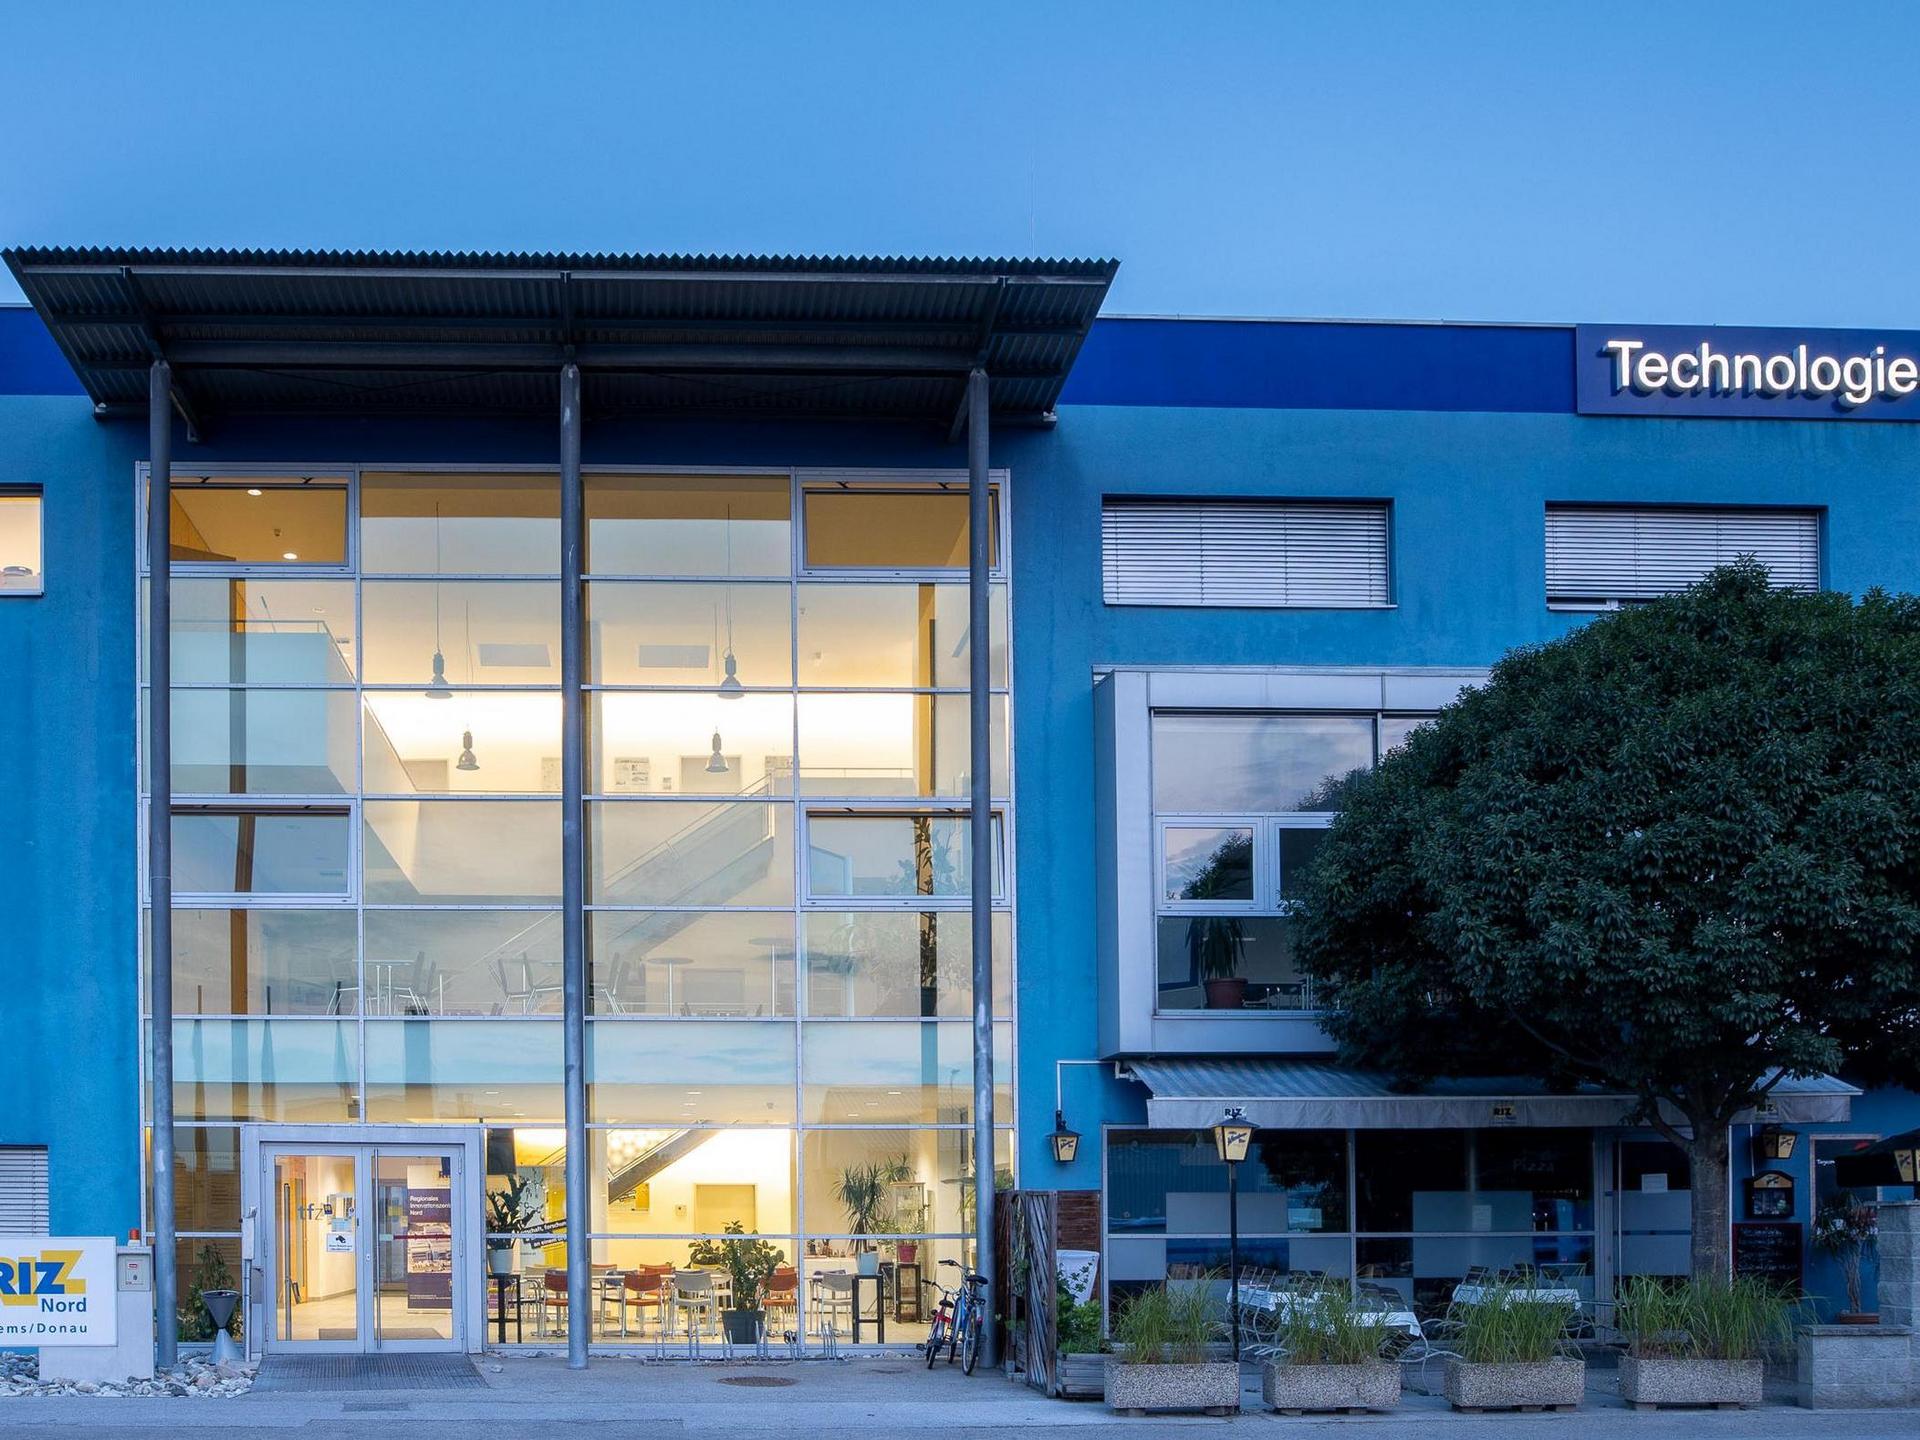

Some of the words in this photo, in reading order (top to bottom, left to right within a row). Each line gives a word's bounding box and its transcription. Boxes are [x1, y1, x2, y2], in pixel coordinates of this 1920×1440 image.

[1607, 340, 1918, 405] Technologie
[0, 1261, 65, 1295] RIZ
[41, 1297, 87, 1313] Nord
